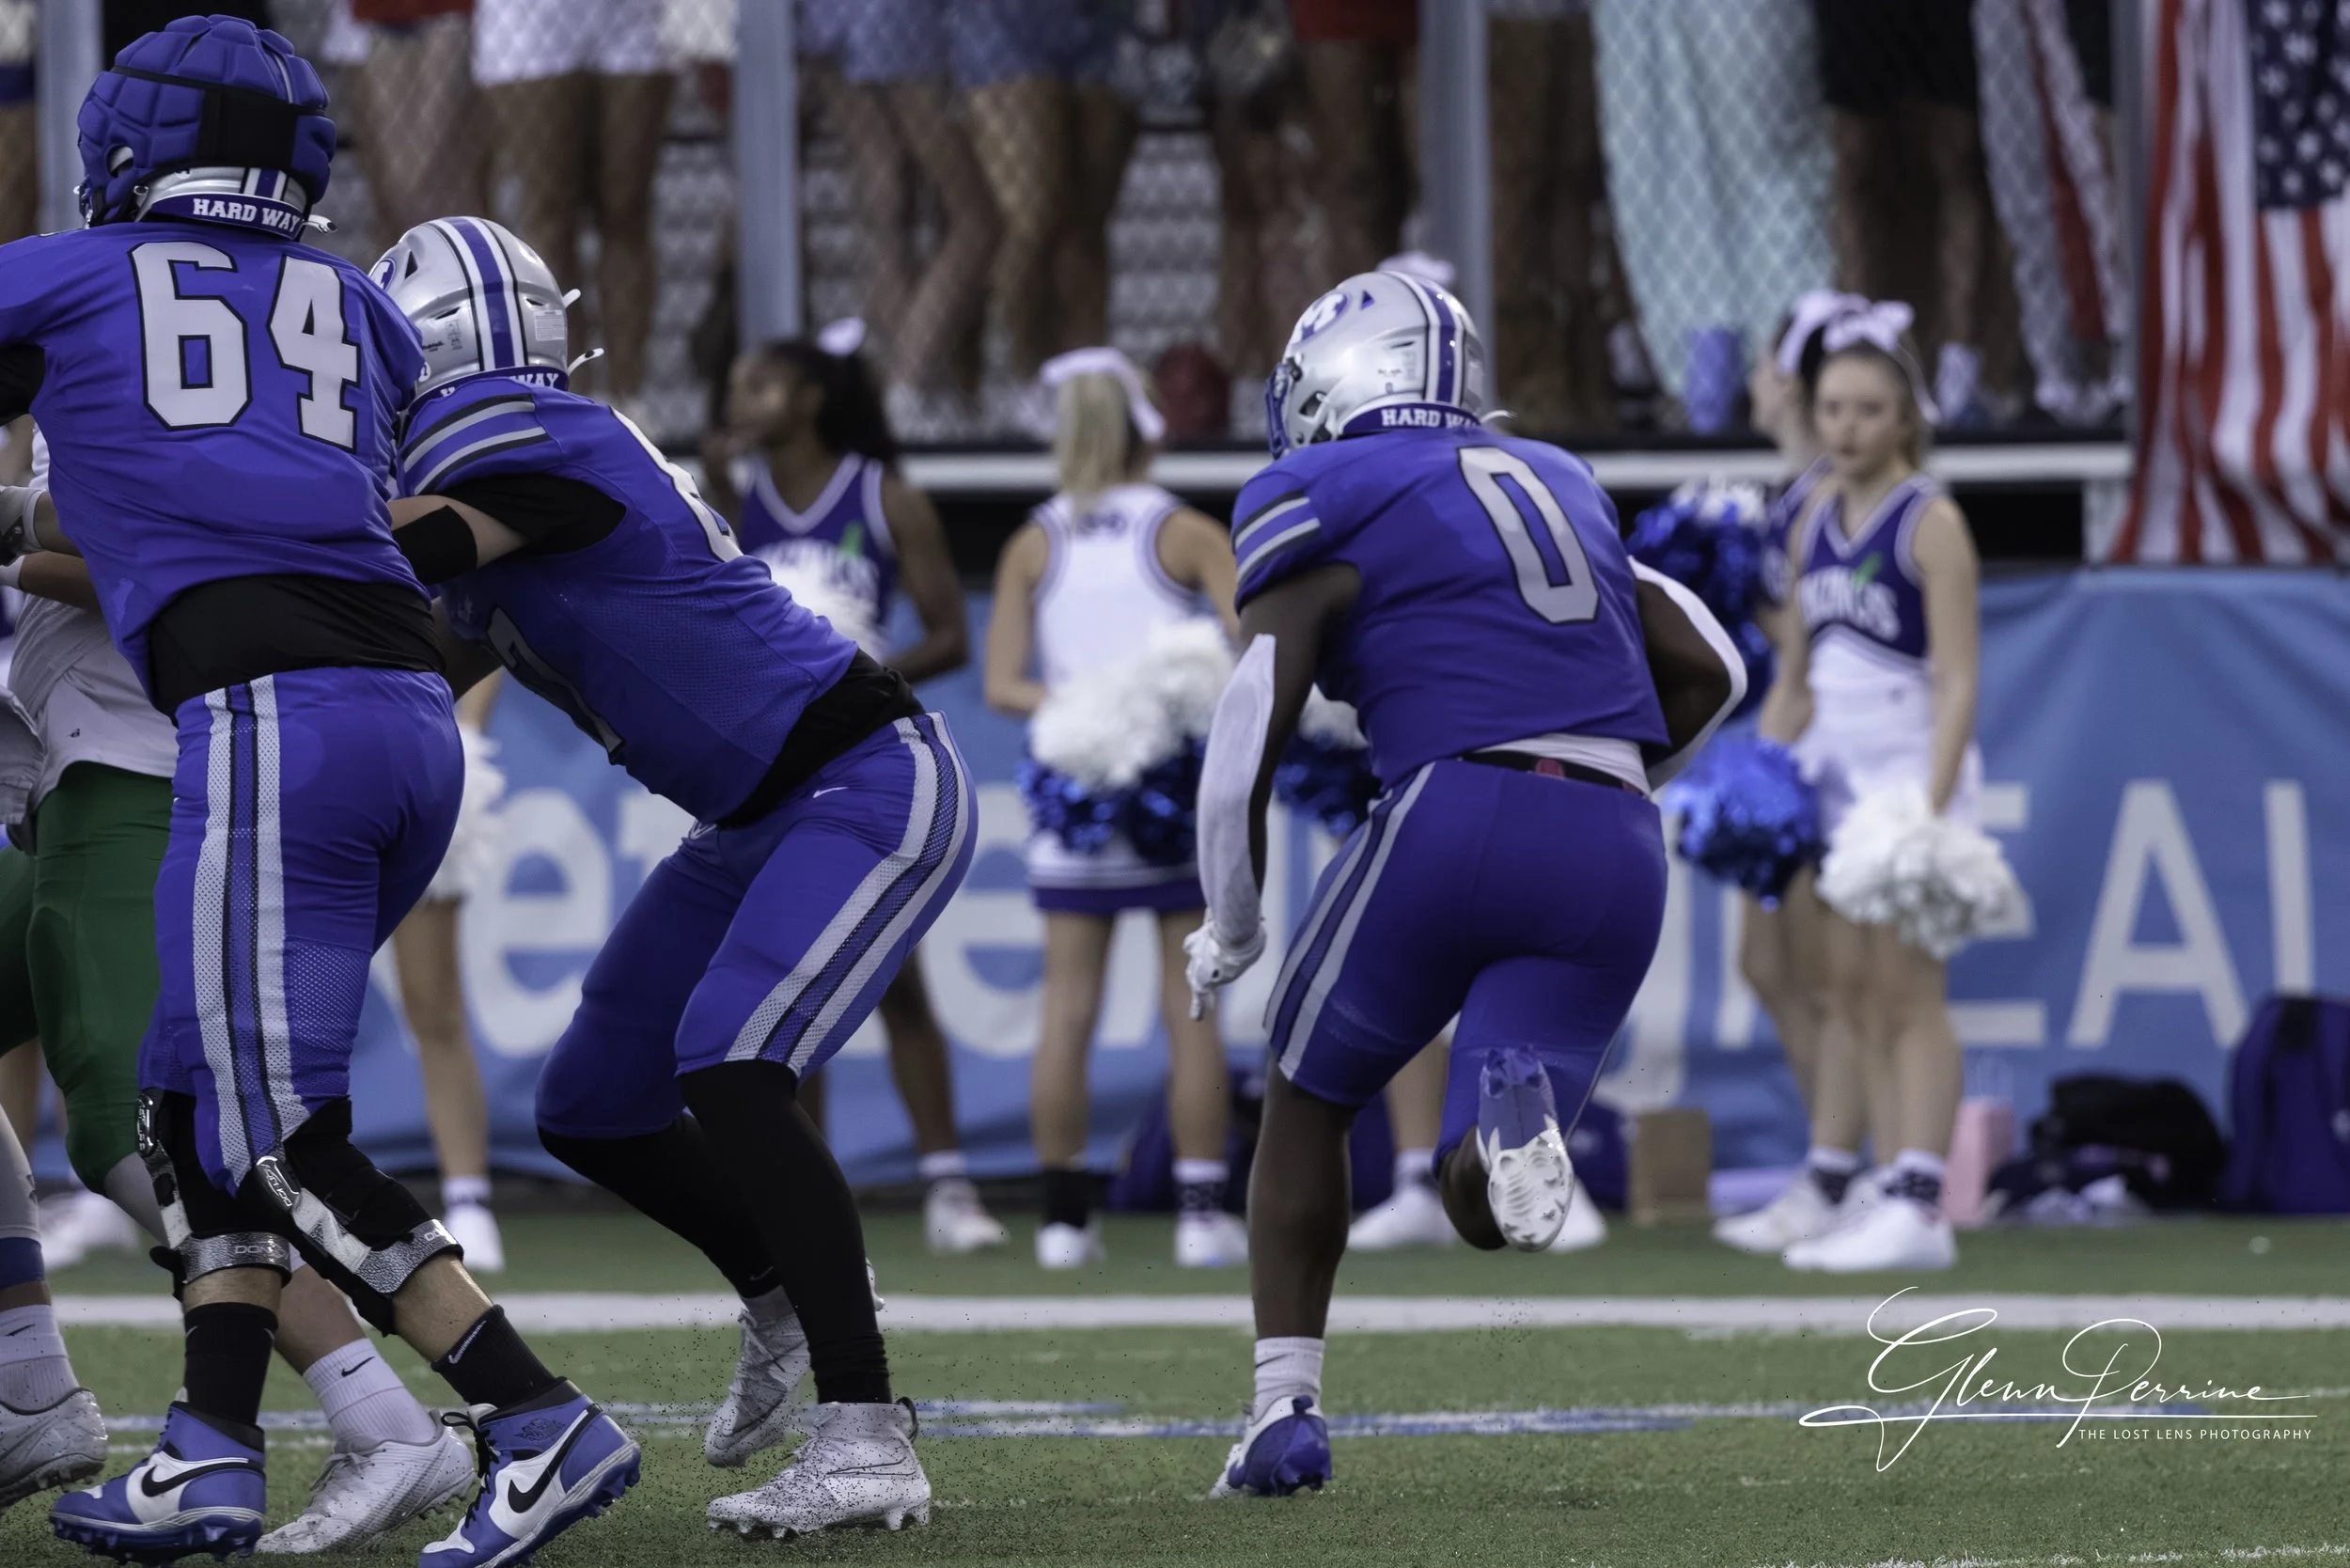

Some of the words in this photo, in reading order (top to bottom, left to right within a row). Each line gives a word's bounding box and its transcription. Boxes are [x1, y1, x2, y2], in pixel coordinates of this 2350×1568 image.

[193, 198, 257, 222] HARD
[261, 207, 304, 233] WAY
[127, 241, 361, 454] 64
[1381, 408, 1441, 428] HARD
[1456, 446, 1599, 626] 0
